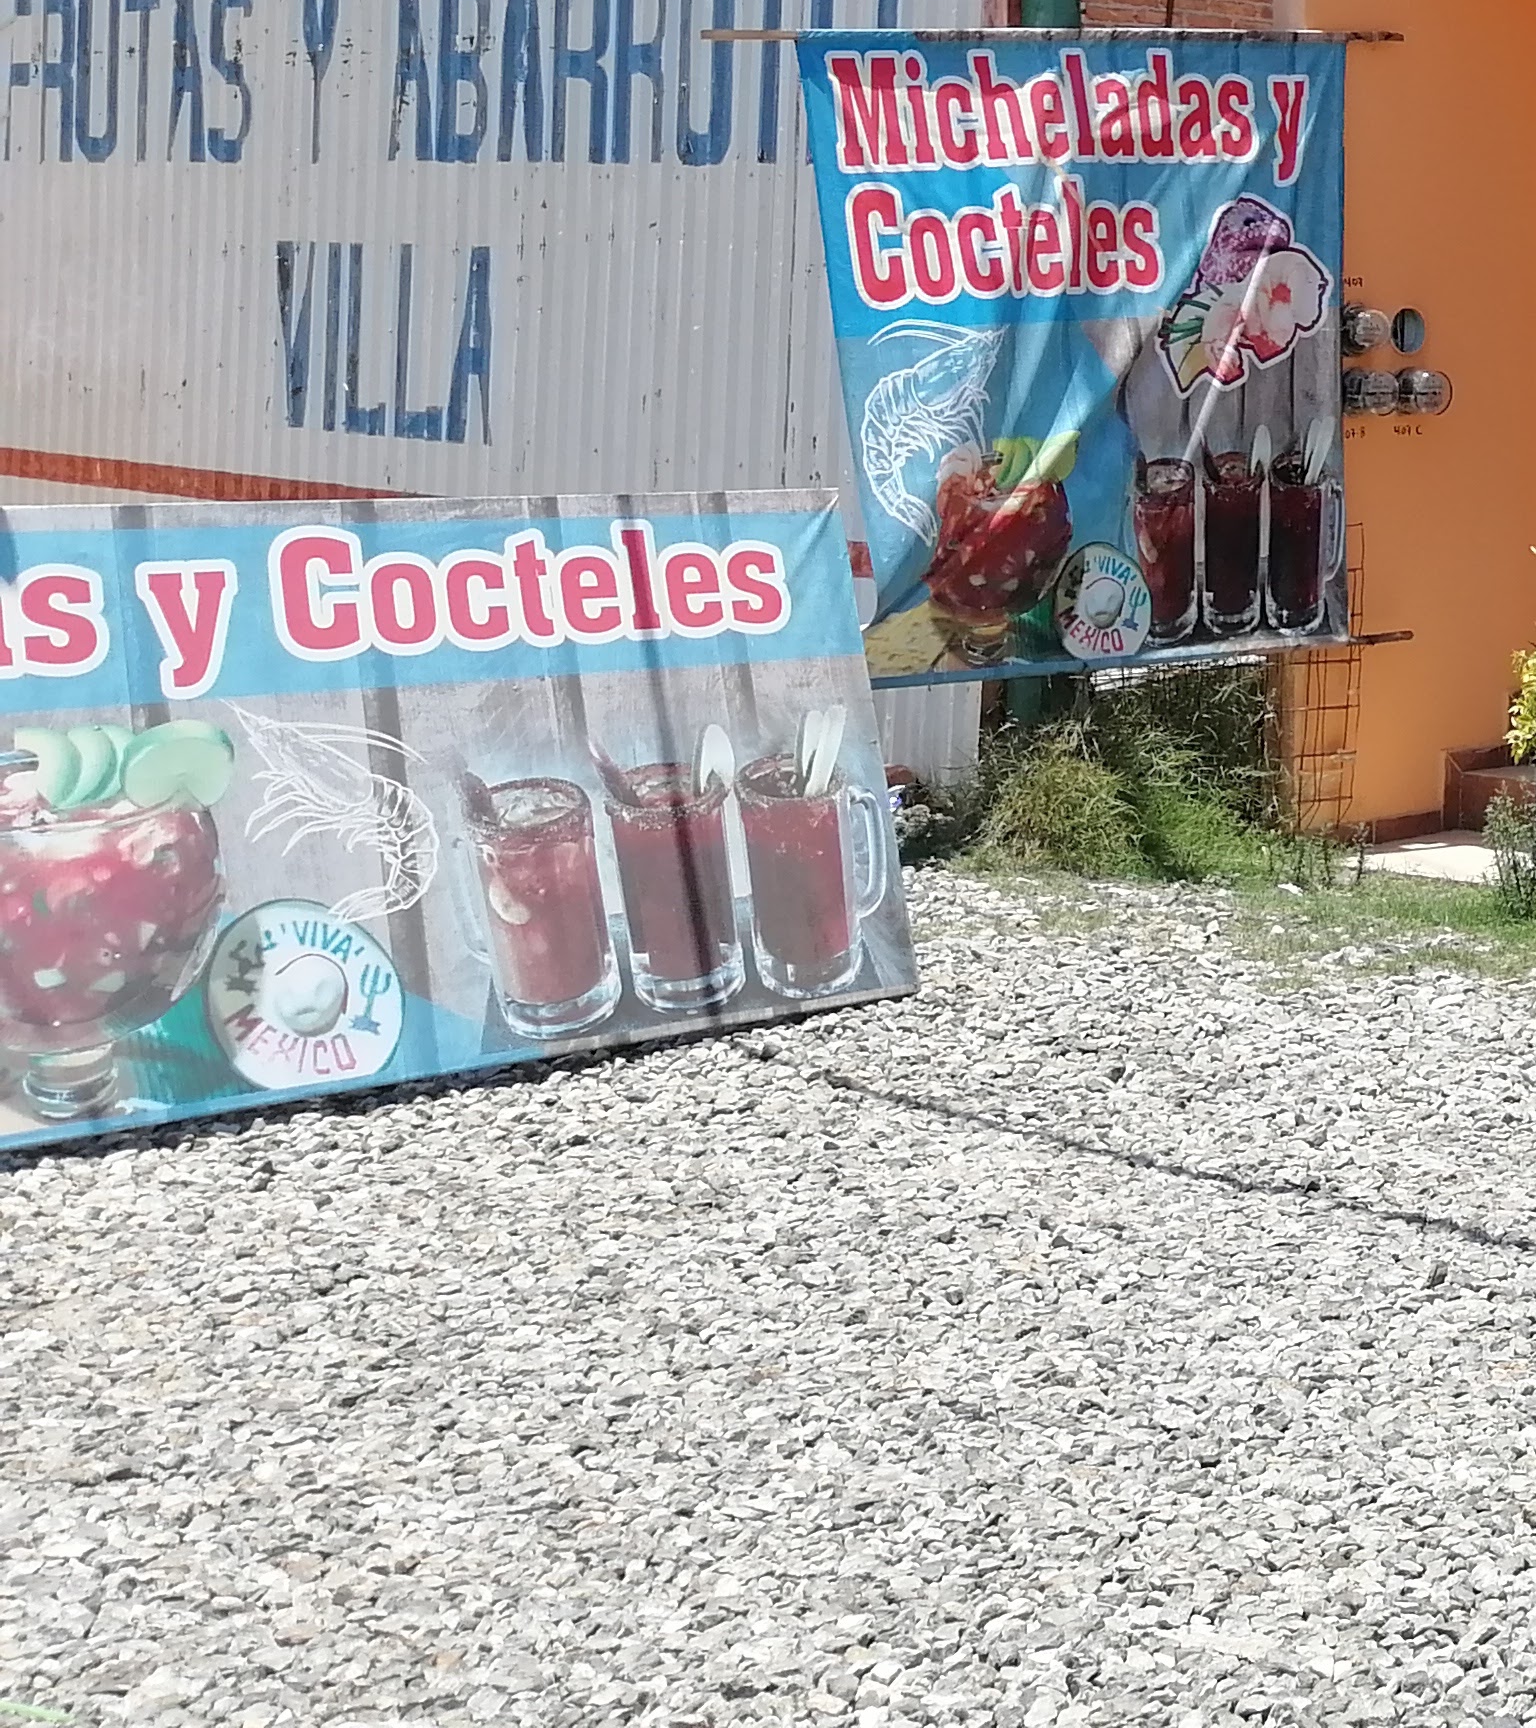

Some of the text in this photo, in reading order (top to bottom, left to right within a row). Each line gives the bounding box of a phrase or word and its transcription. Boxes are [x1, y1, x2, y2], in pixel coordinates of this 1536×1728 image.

[830, 53, 1306, 183] Micheladas y
[850, 179, 1160, 304] Cocteles
[275, 239, 493, 447] VILLA
[0, 526, 784, 689] s y Cocteles
[1058, 605, 1125, 654] MEXICO
[223, 1002, 358, 1075] MEXICO
